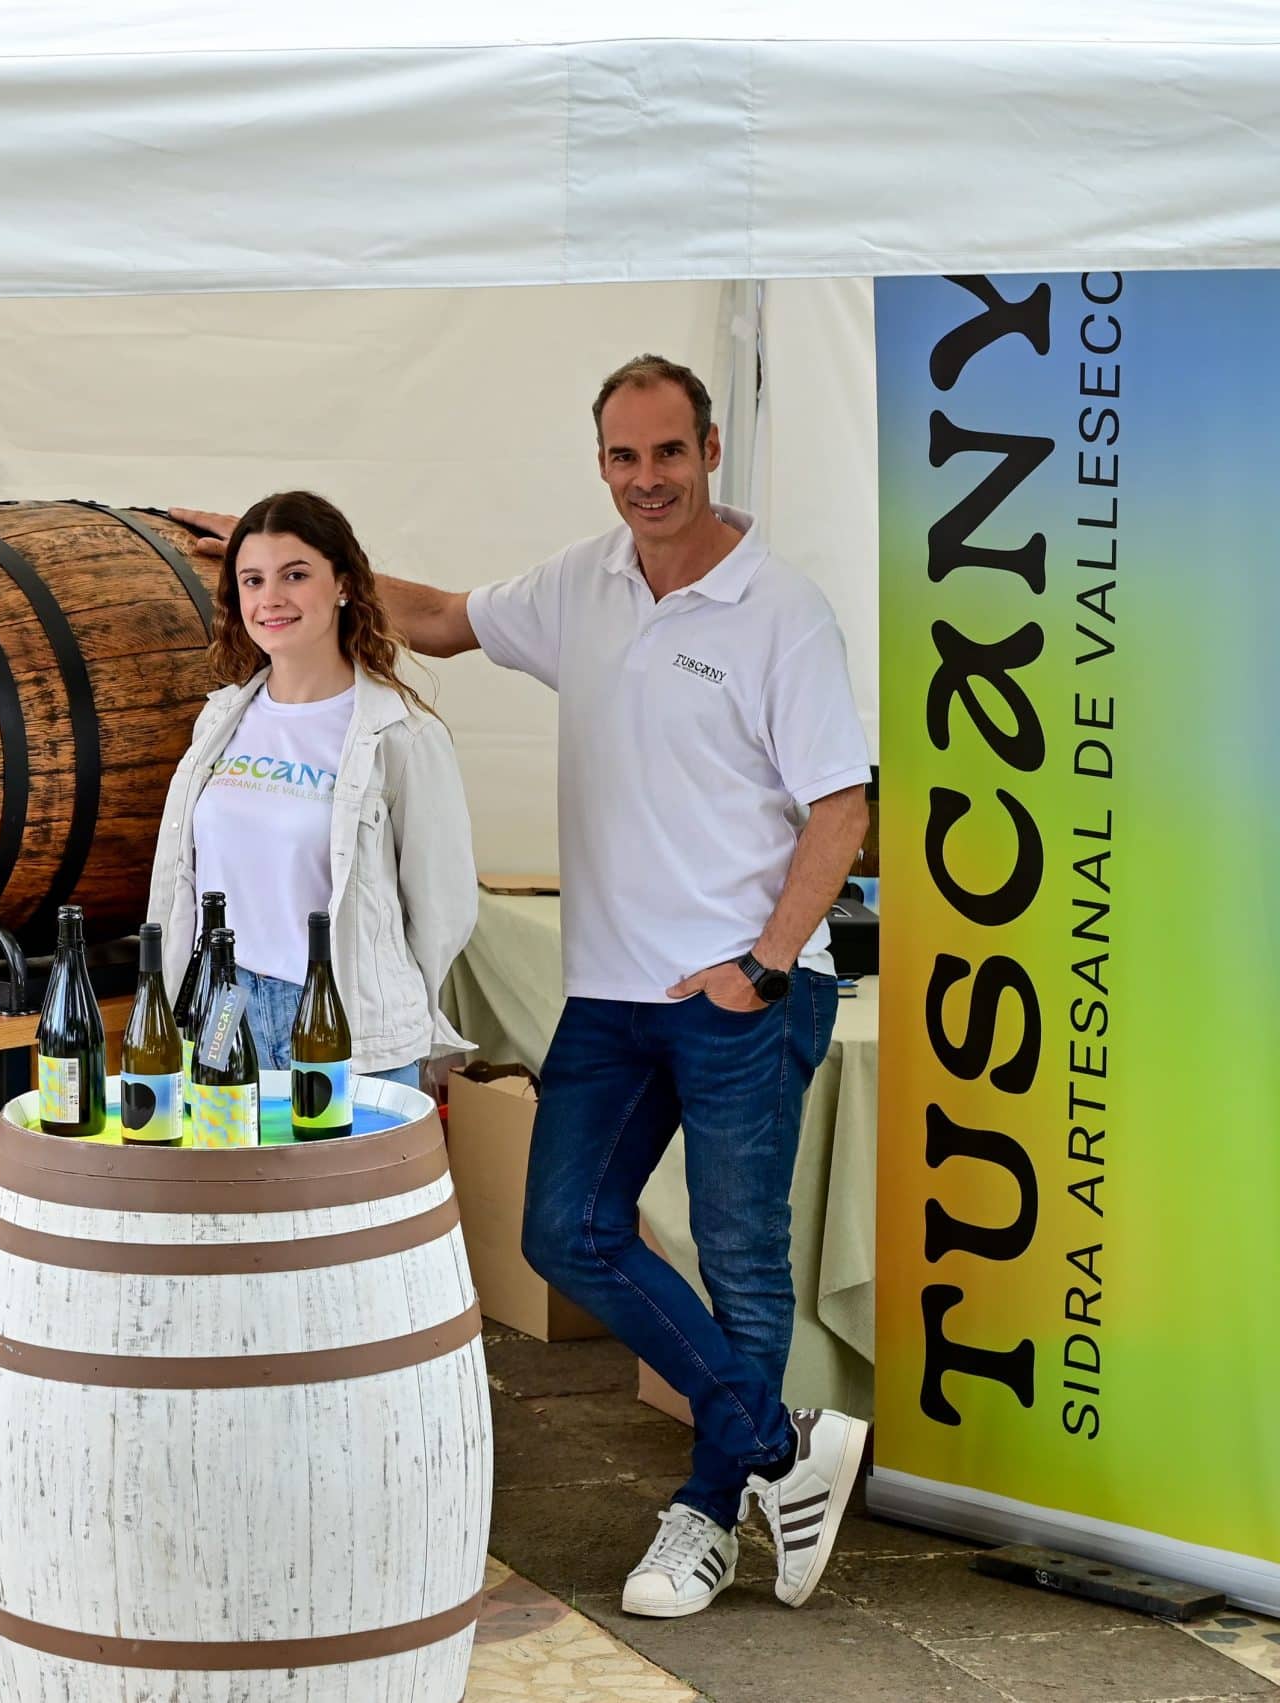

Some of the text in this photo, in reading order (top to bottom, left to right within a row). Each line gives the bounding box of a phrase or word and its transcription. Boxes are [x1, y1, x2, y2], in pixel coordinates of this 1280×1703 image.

[1061, 270, 1124, 1441] SIDRA ARTESANAL DE VALLESECO
